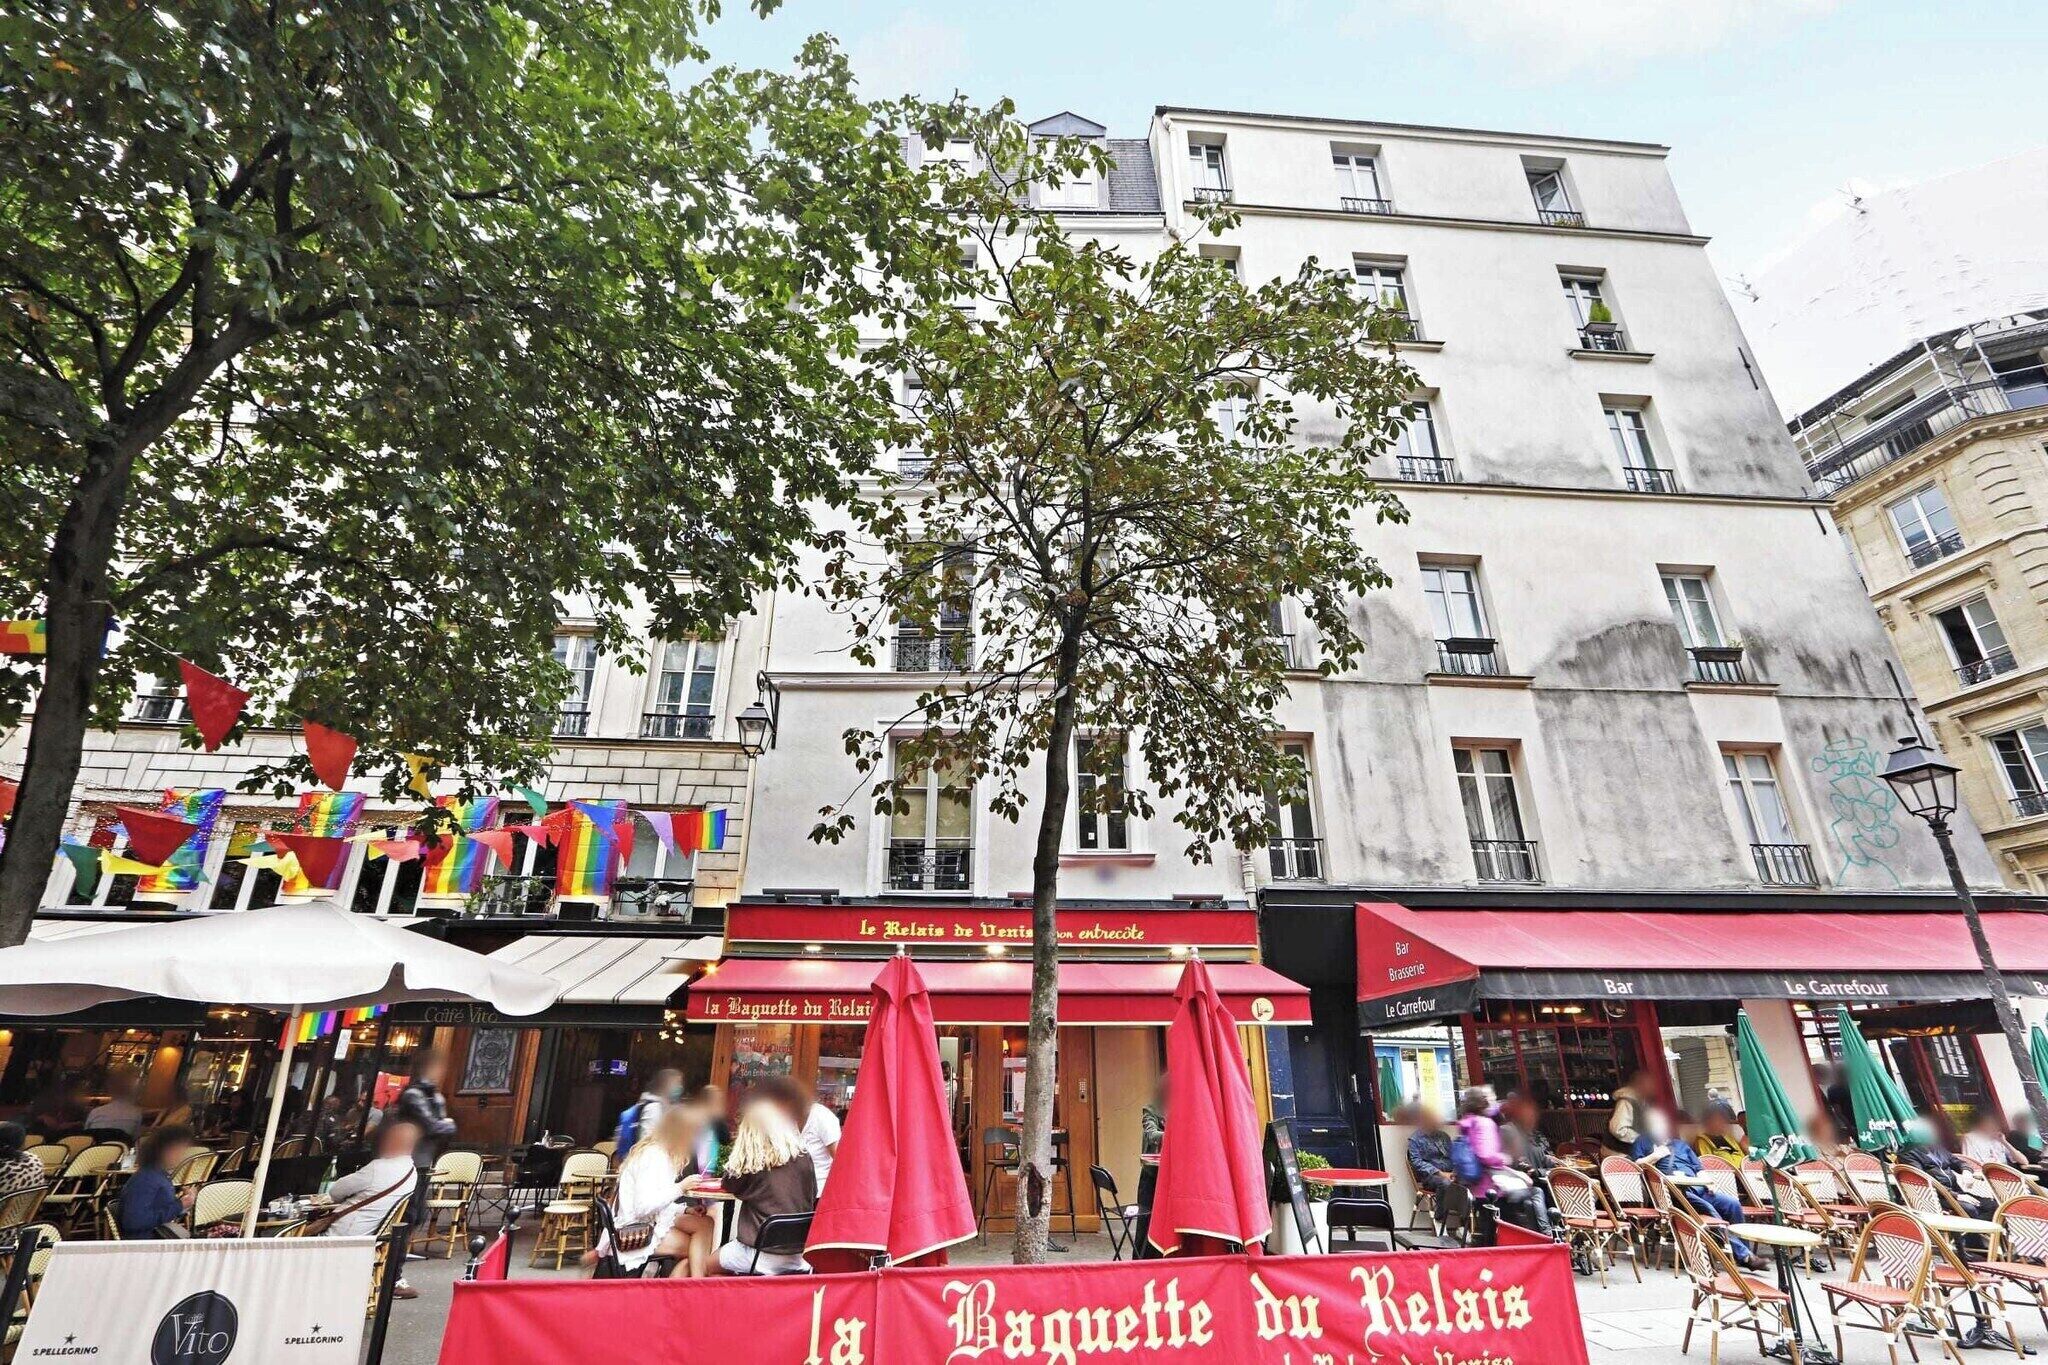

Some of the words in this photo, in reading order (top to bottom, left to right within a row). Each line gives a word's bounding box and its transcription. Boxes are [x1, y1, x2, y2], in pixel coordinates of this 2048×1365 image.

[860, 919, 876, 936] le
[884, 921, 945, 939] Relais
[954, 923, 973, 937] de
[980, 922, 1033, 938] Venis
[1078, 923, 1145, 940] entrecôte
[1395, 942, 1410, 956] Bar
[1388, 960, 1426, 982] Brasserie
[1603, 979, 1633, 994] Bar
[1784, 981, 1807, 995] Le
[1808, 980, 1889, 995] Carrefour
[468, 1003, 499, 1023] Vito
[704, 997, 720, 1014] la
[726, 997, 798, 1020] Baguette
[803, 1000, 823, 1015] du
[1385, 1003, 1395, 1018] Le
[1396, 996, 1436, 1016] Carrefour
[803, 1284, 867, 1365] la
[942, 1277, 1213, 1365] Baguette
[1250, 1272, 1323, 1340] du
[1351, 1263, 1533, 1357] Relais
[171, 1313, 229, 1356] Vito
[284, 1335, 343, 1345] S.PELLEGRINO
[33, 1346, 98, 1356] S.PELLEGRINO
